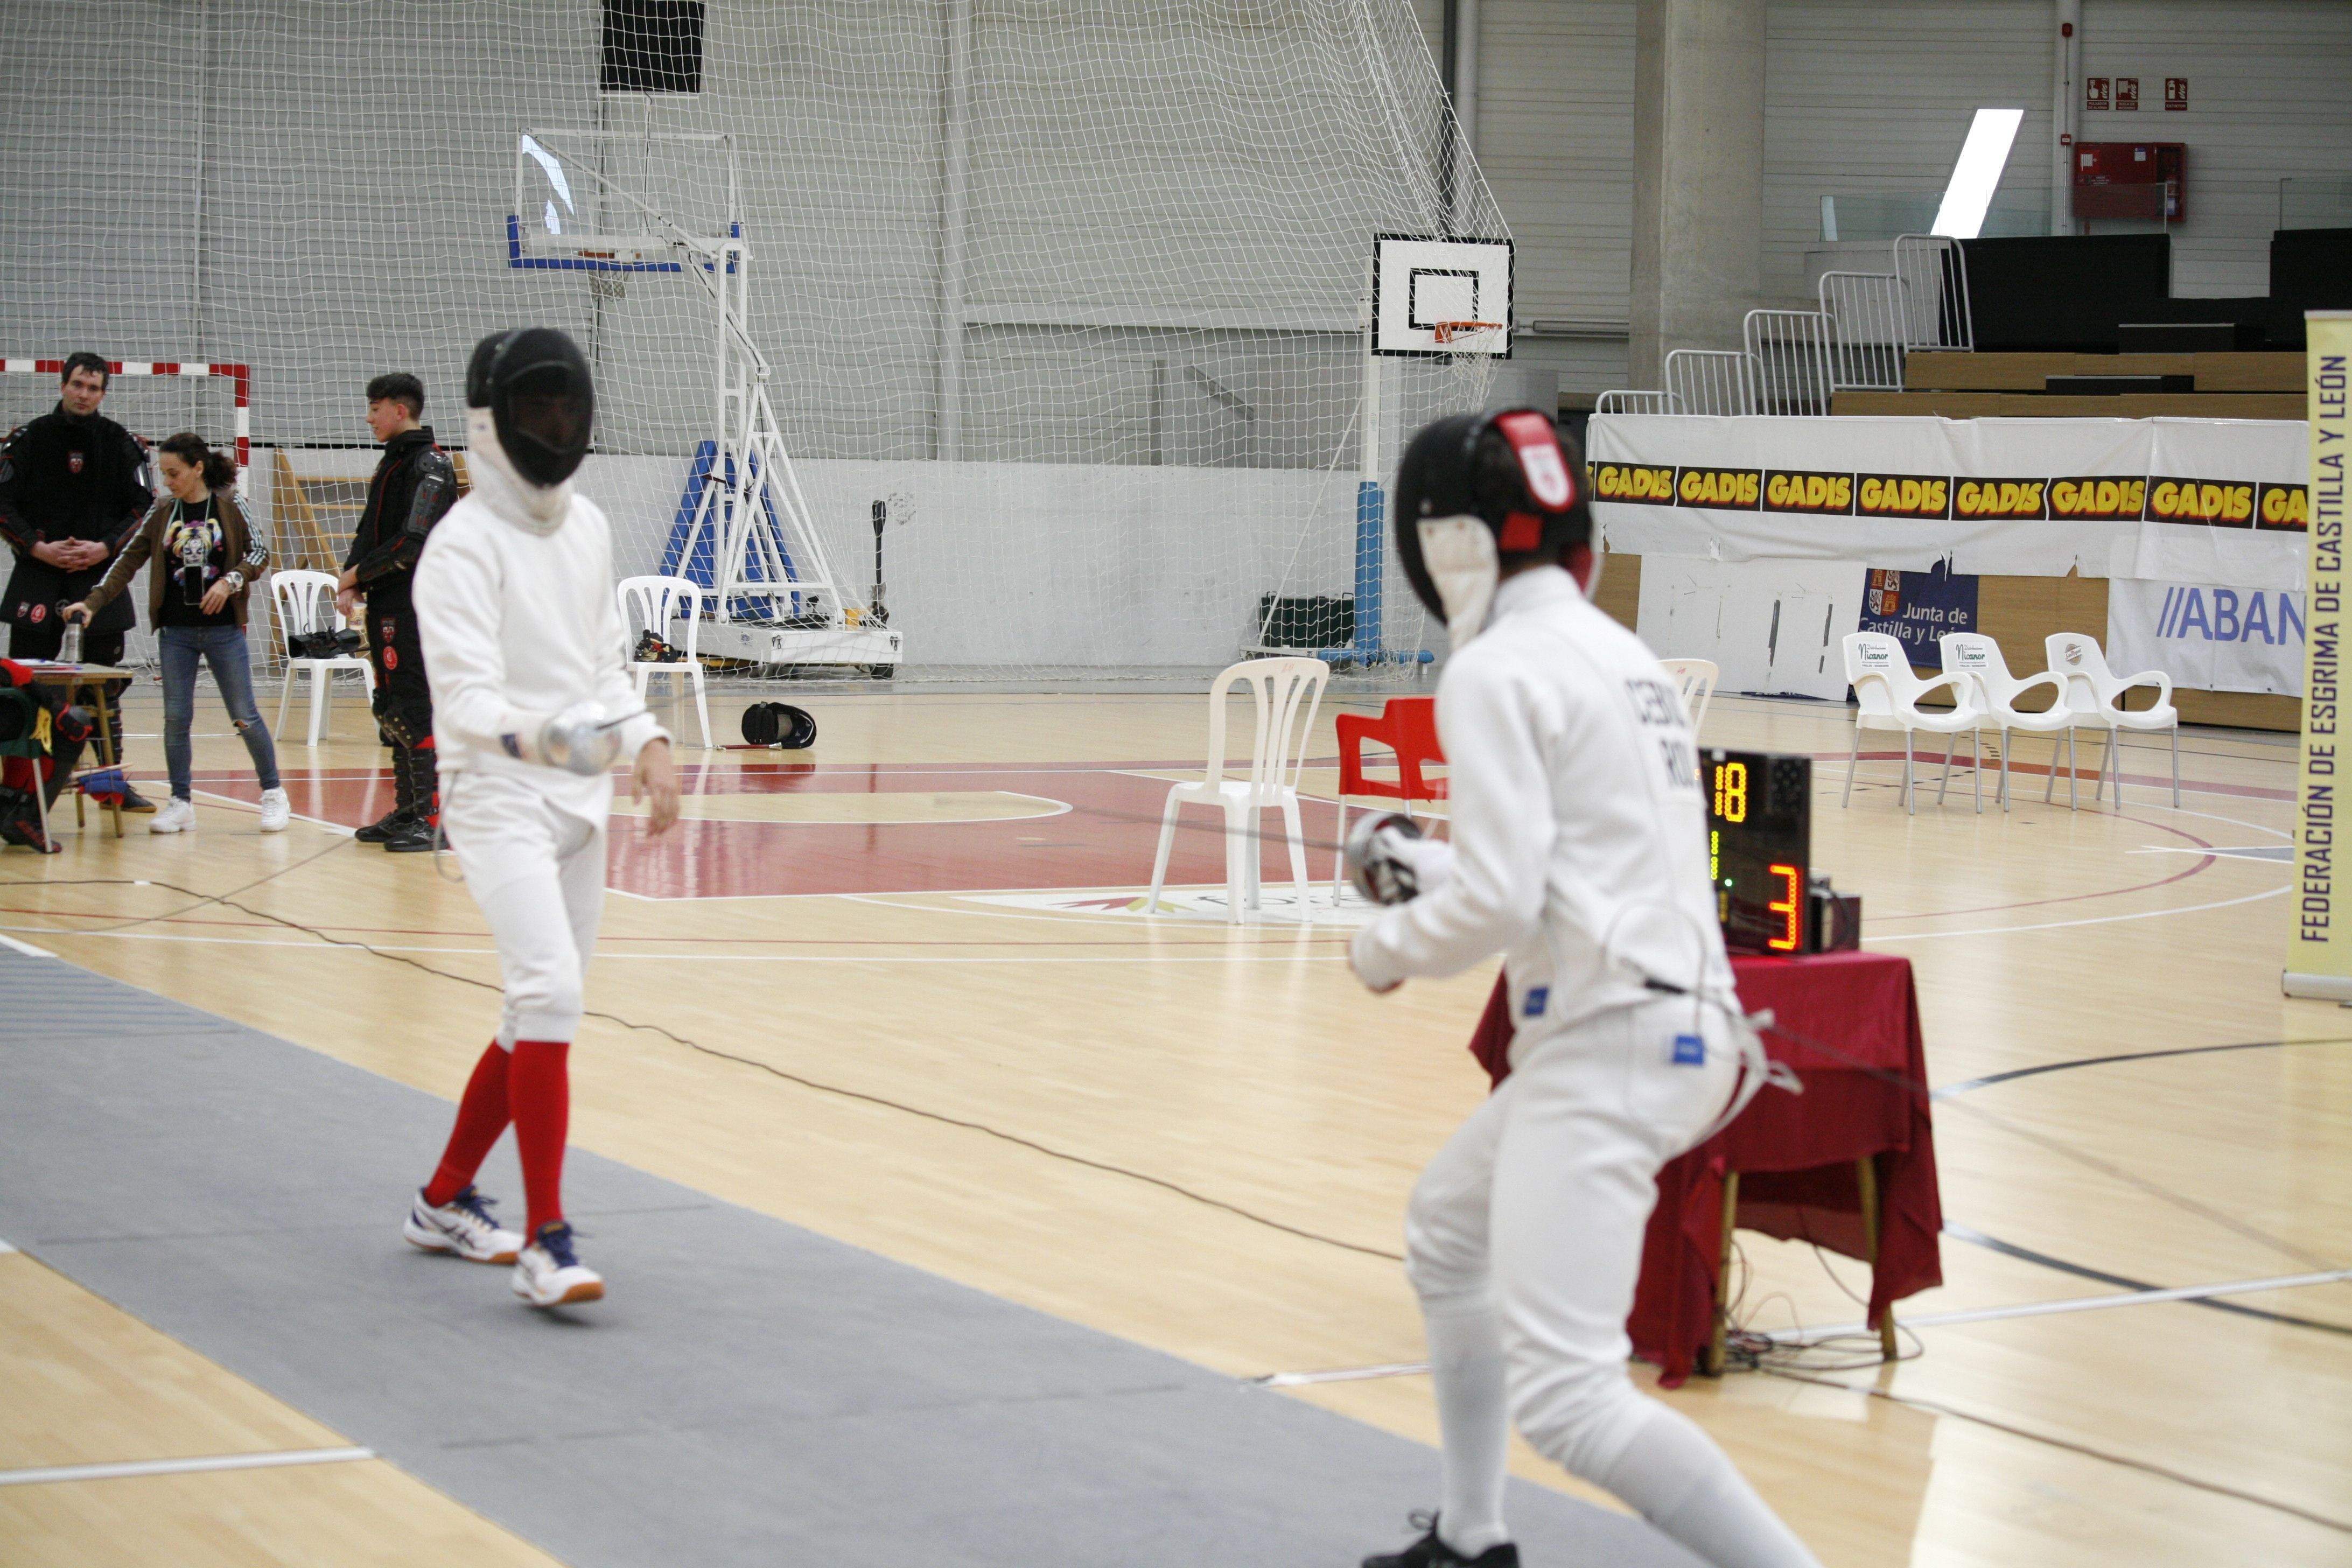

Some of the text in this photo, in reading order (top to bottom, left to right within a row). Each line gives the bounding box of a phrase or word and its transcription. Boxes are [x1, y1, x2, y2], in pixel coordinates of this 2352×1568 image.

[1598, 466, 1673, 499] GADIS
[1679, 471, 1759, 504] GADIS
[1767, 474, 1851, 509] GADIS
[1860, 478, 1947, 513] GADIS
[1957, 481, 2044, 516] GADIS
[2052, 481, 2145, 516] GADIS
[2152, 481, 2252, 522] GADIS
[1859, 617, 1911, 639] Castilla
[1914, 627, 1925, 645] y
[1902, 603, 1968, 625] Junta de
[2301, 356, 2346, 942] FEDERACIÓN DE ESGRIMA DE CASTILLA Y LEÓN
[1769, 864, 1797, 950] 3
